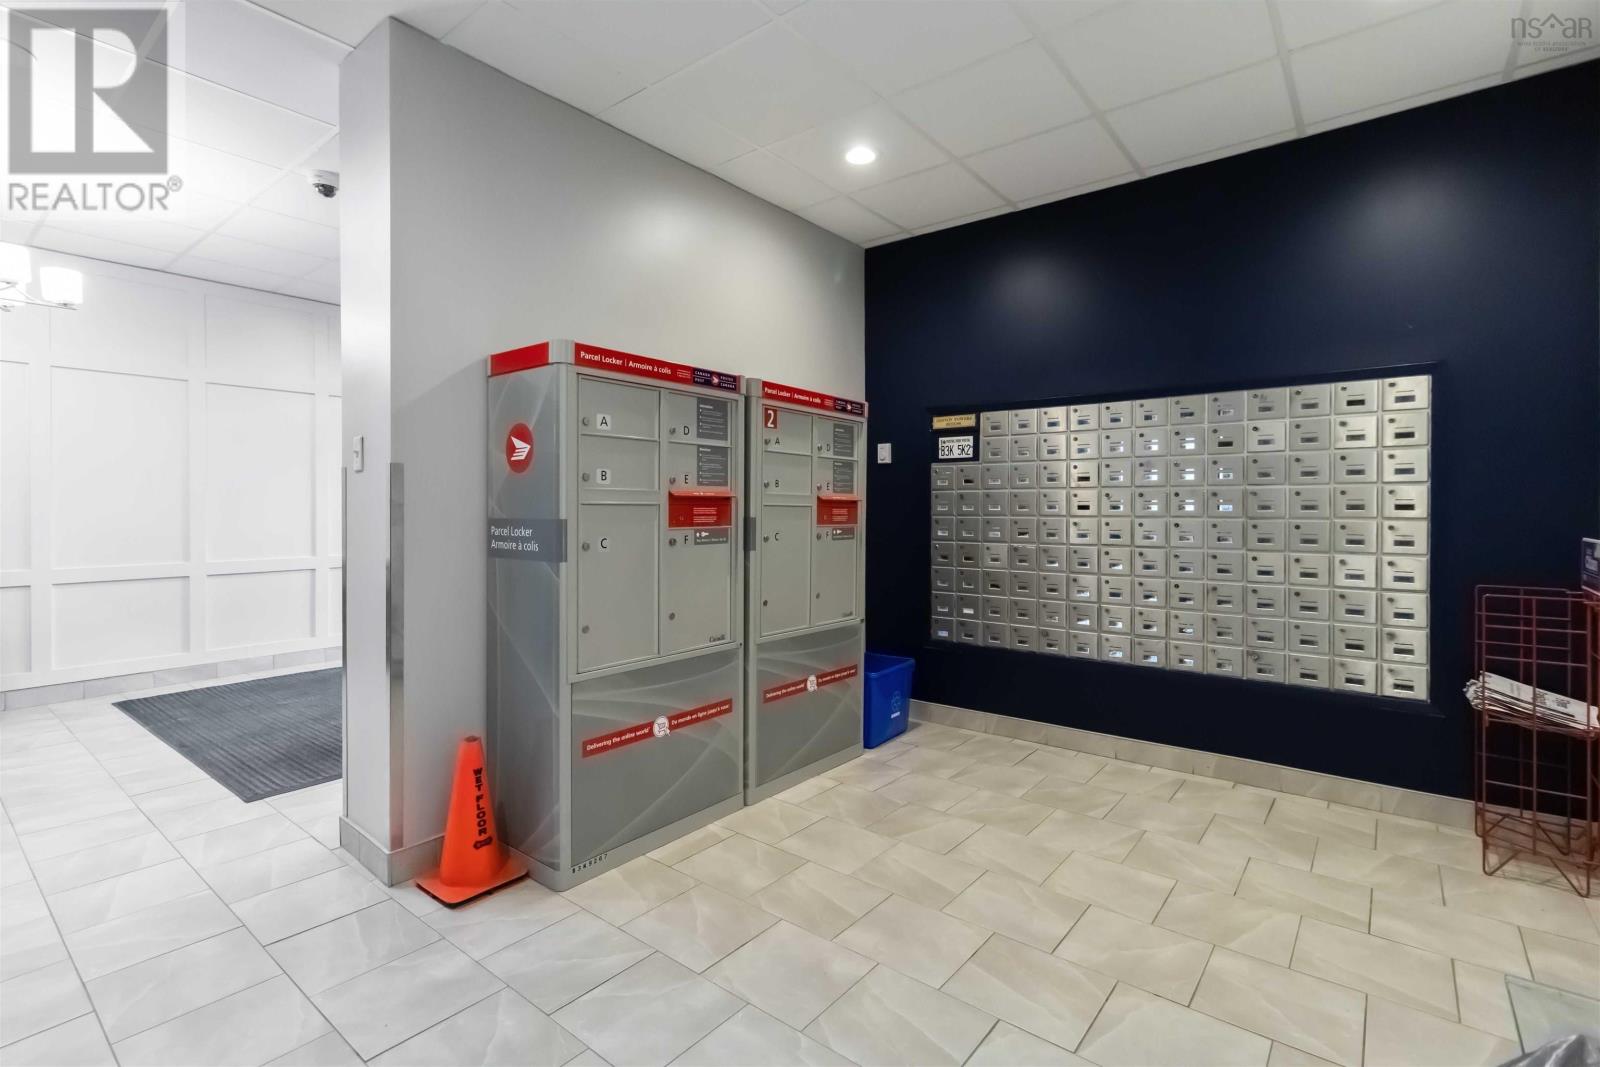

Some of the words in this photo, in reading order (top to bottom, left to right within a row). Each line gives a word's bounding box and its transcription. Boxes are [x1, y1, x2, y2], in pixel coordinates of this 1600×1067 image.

[580, 351, 601, 361] Parcel
[602, 355, 623, 366] Locker
[628, 361, 653, 371] Armoire
[659, 367, 671, 375] colis
[765, 387, 778, 395] Parcel
[778, 390, 791, 398] Locker
[600, 416, 608, 427] A
[767, 410, 775, 428] 2
[683, 426, 690, 436] D
[941, 445, 954, 456] B3K
[957, 444, 971, 456] 5K2
[600, 470, 607, 481] B
[684, 475, 689, 484] E
[775, 480, 779, 488] B
[491, 525, 510, 536] Parcel
[510, 526, 533, 537] Locker
[684, 535, 689, 544] F
[775, 533, 780, 541] C
[491, 539, 517, 550] Armoire
[518, 540, 522, 551] à
[524, 541, 539, 552] colis
[600, 538, 607, 549] C
[586, 739, 612, 751] Delivering
[612, 735, 620, 743] the
[621, 731, 635, 741] online
[473, 767, 483, 791] WET
[475, 794, 487, 836] FLOOR
